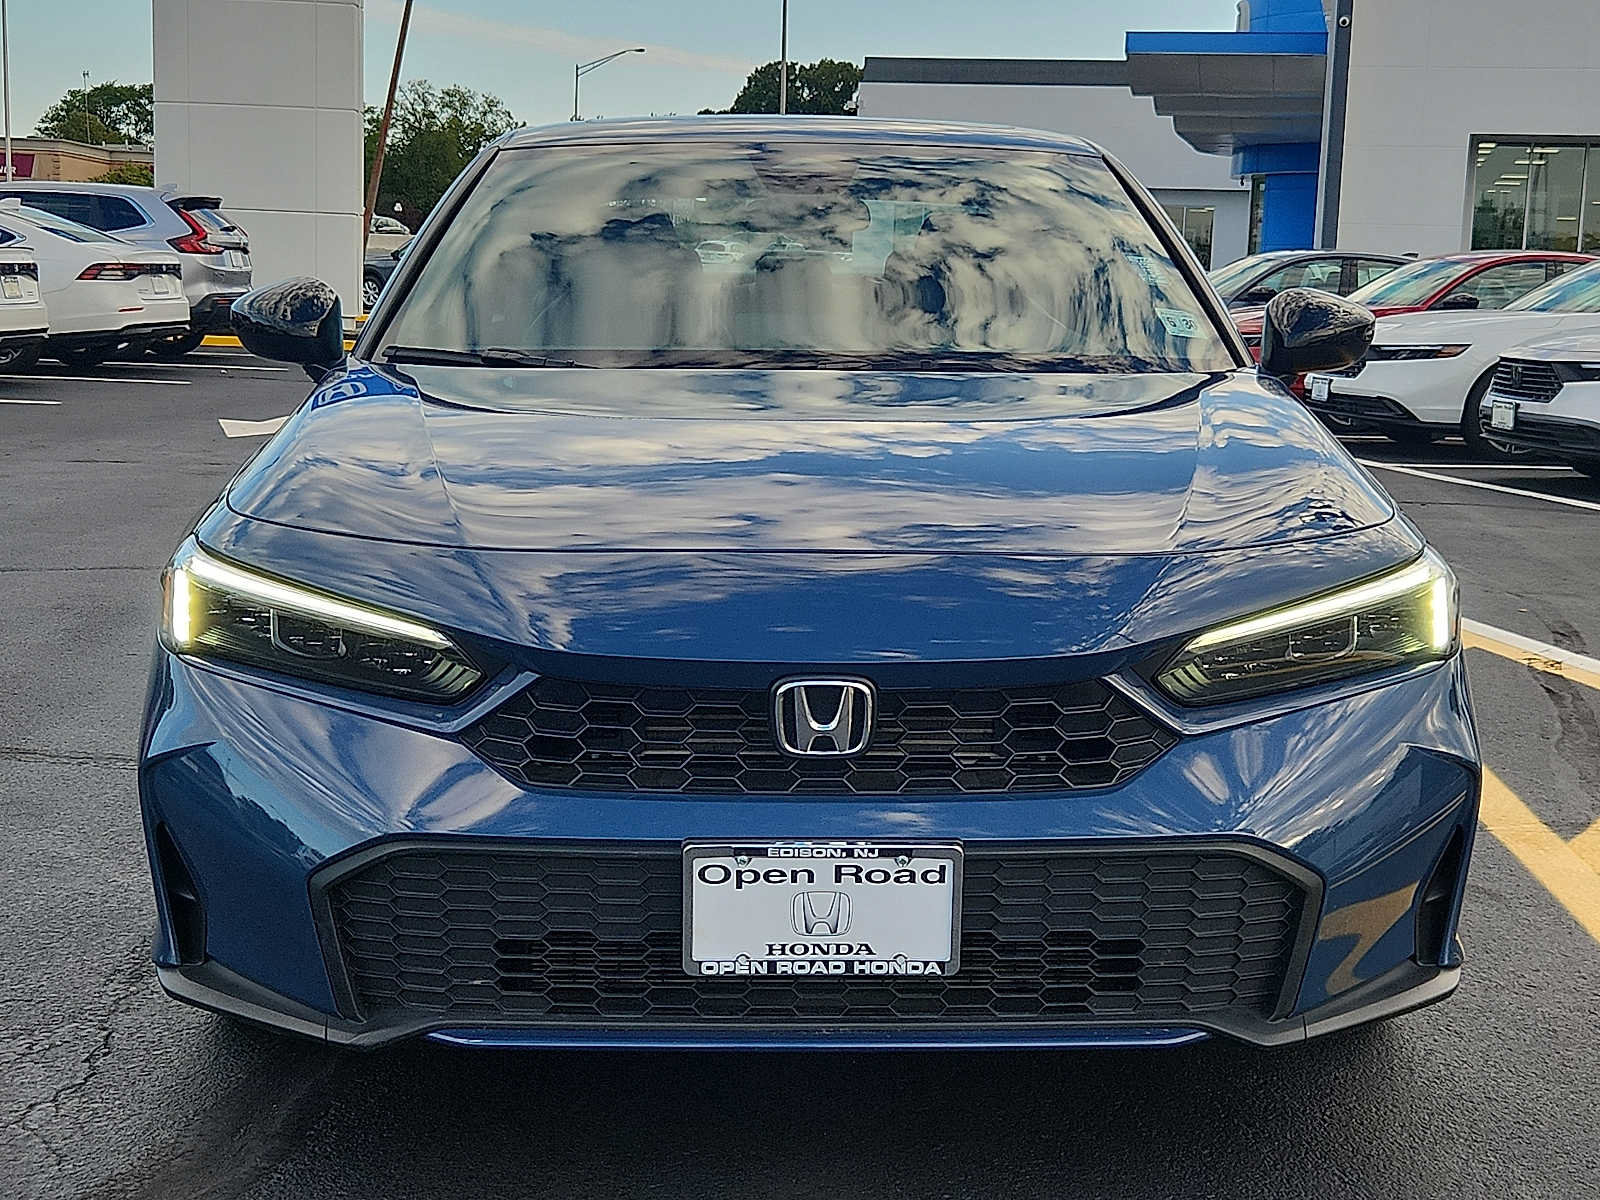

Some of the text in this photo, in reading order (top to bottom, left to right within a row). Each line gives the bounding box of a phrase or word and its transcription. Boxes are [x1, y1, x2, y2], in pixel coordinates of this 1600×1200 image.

[767, 848, 879, 858] EDISON, NJ
[697, 864, 947, 890] Open Road
[765, 943, 877, 956] HONDA
[700, 961, 942, 975] OPEN ROAD HONDA
